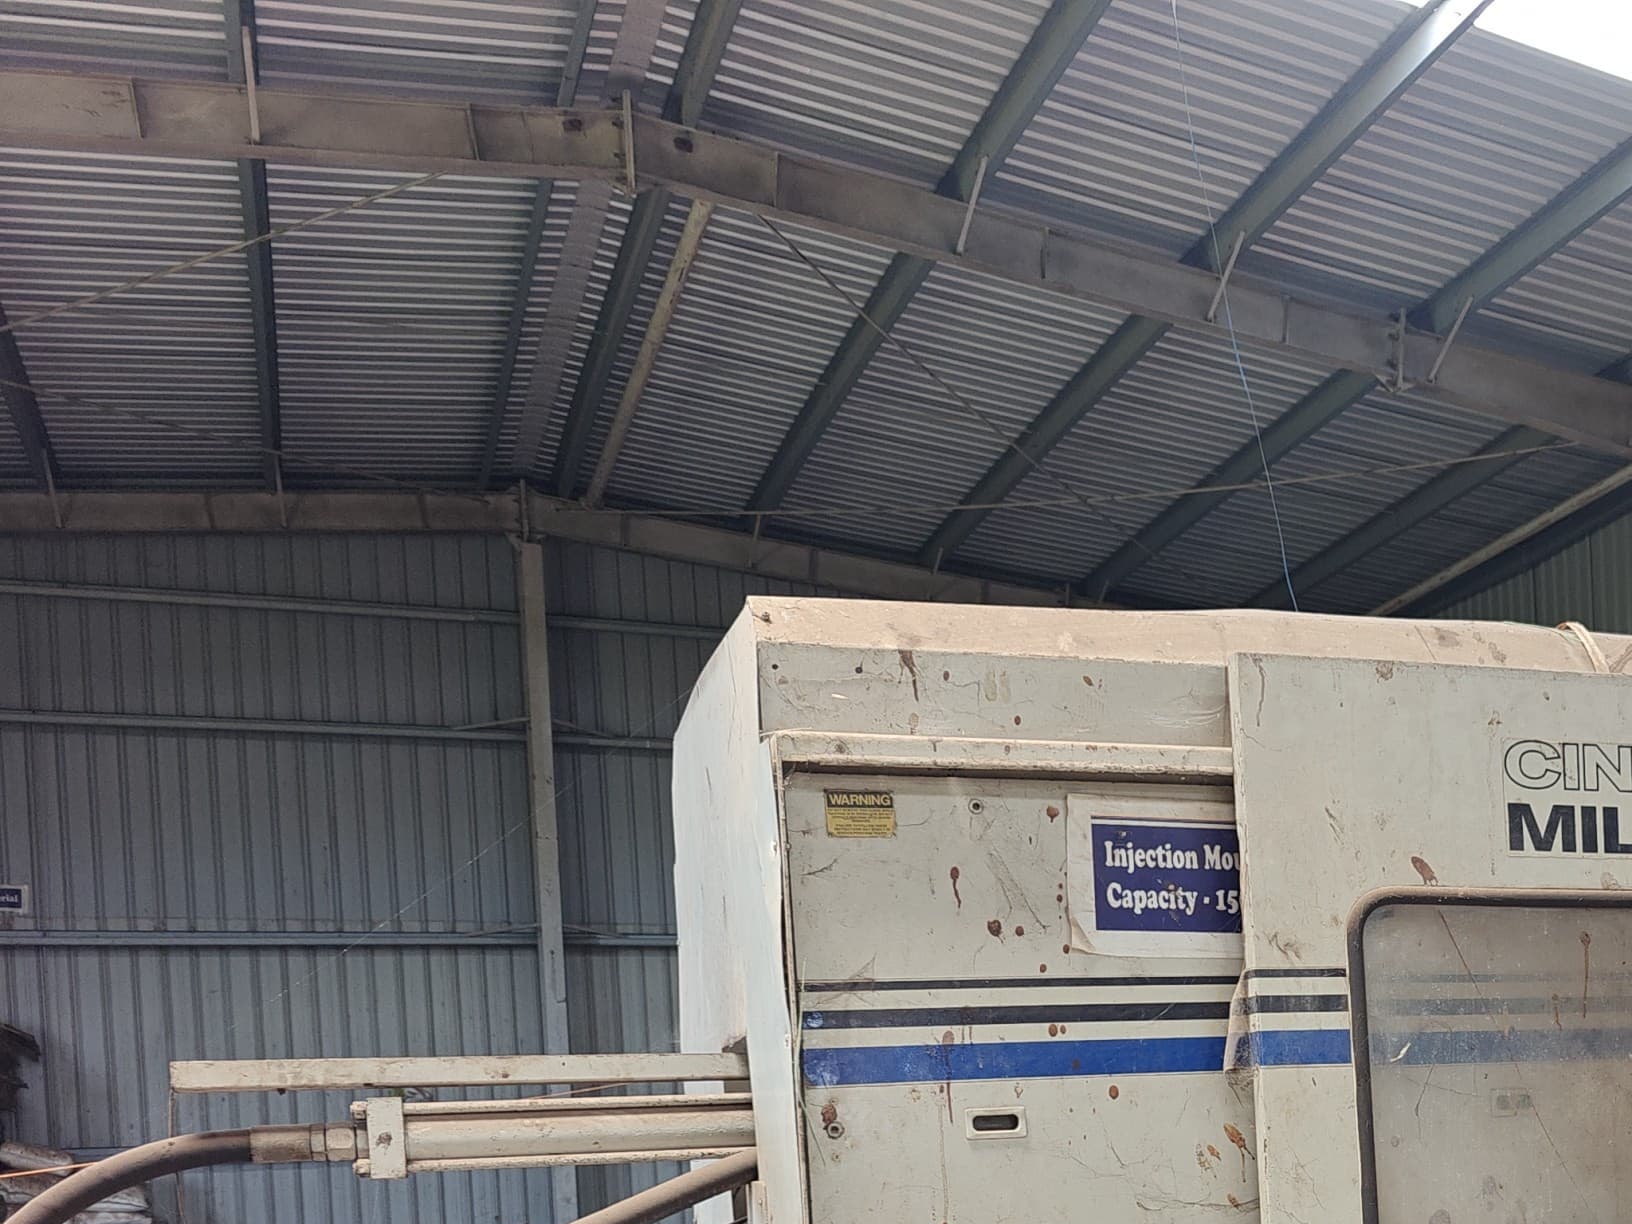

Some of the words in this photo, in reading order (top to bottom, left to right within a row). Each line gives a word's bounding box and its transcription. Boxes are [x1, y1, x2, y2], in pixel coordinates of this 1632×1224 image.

[828, 793, 892, 806] WARNING
[1104, 840, 1199, 874] Injection
[1106, 882, 1198, 916] Capacity
